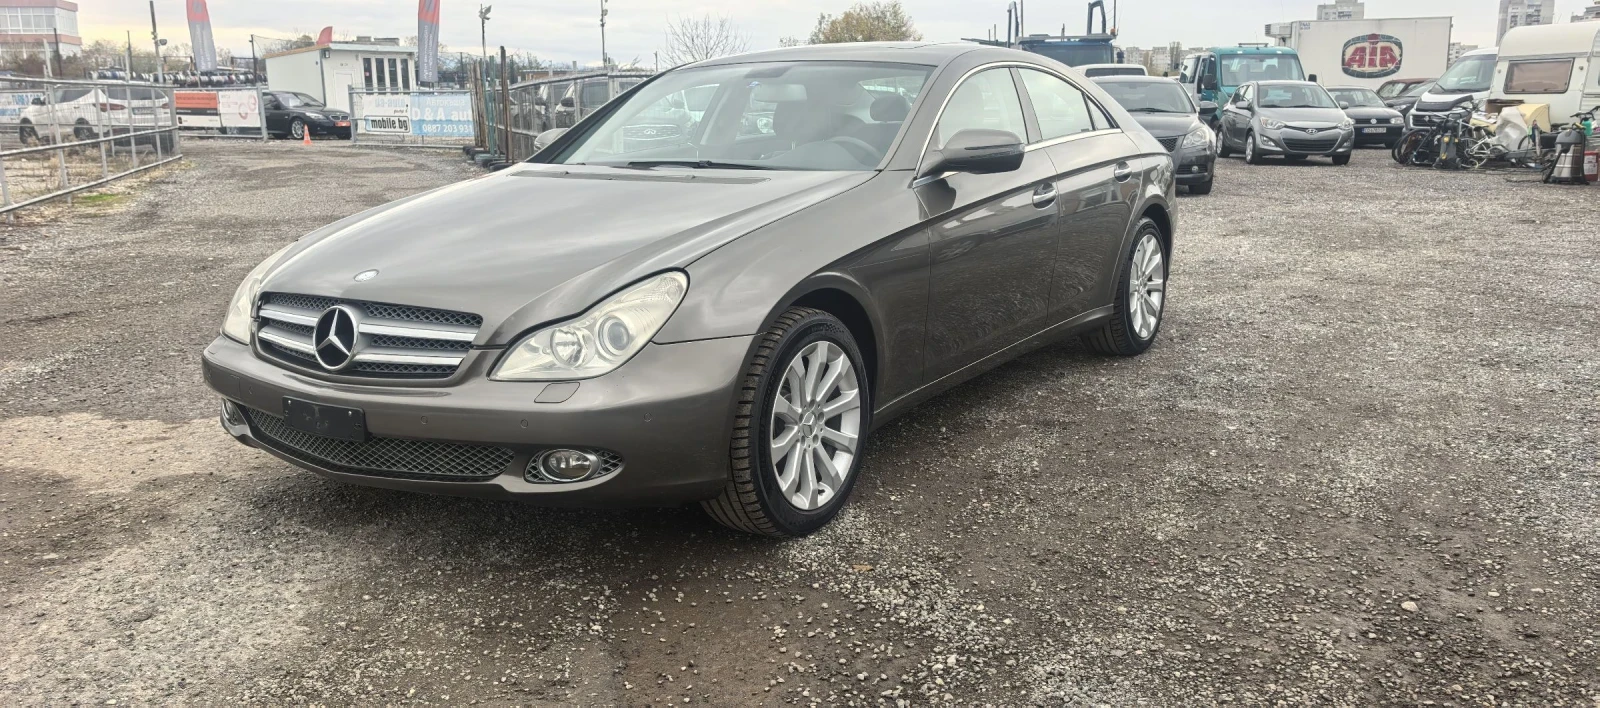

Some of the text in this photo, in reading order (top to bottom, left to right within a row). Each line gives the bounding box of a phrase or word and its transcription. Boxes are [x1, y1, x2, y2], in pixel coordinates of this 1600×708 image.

[411, 108, 421, 121] D
[424, 108, 434, 121] &
[436, 108, 446, 121] A
[422, 124, 473, 133] 0887 203 931
